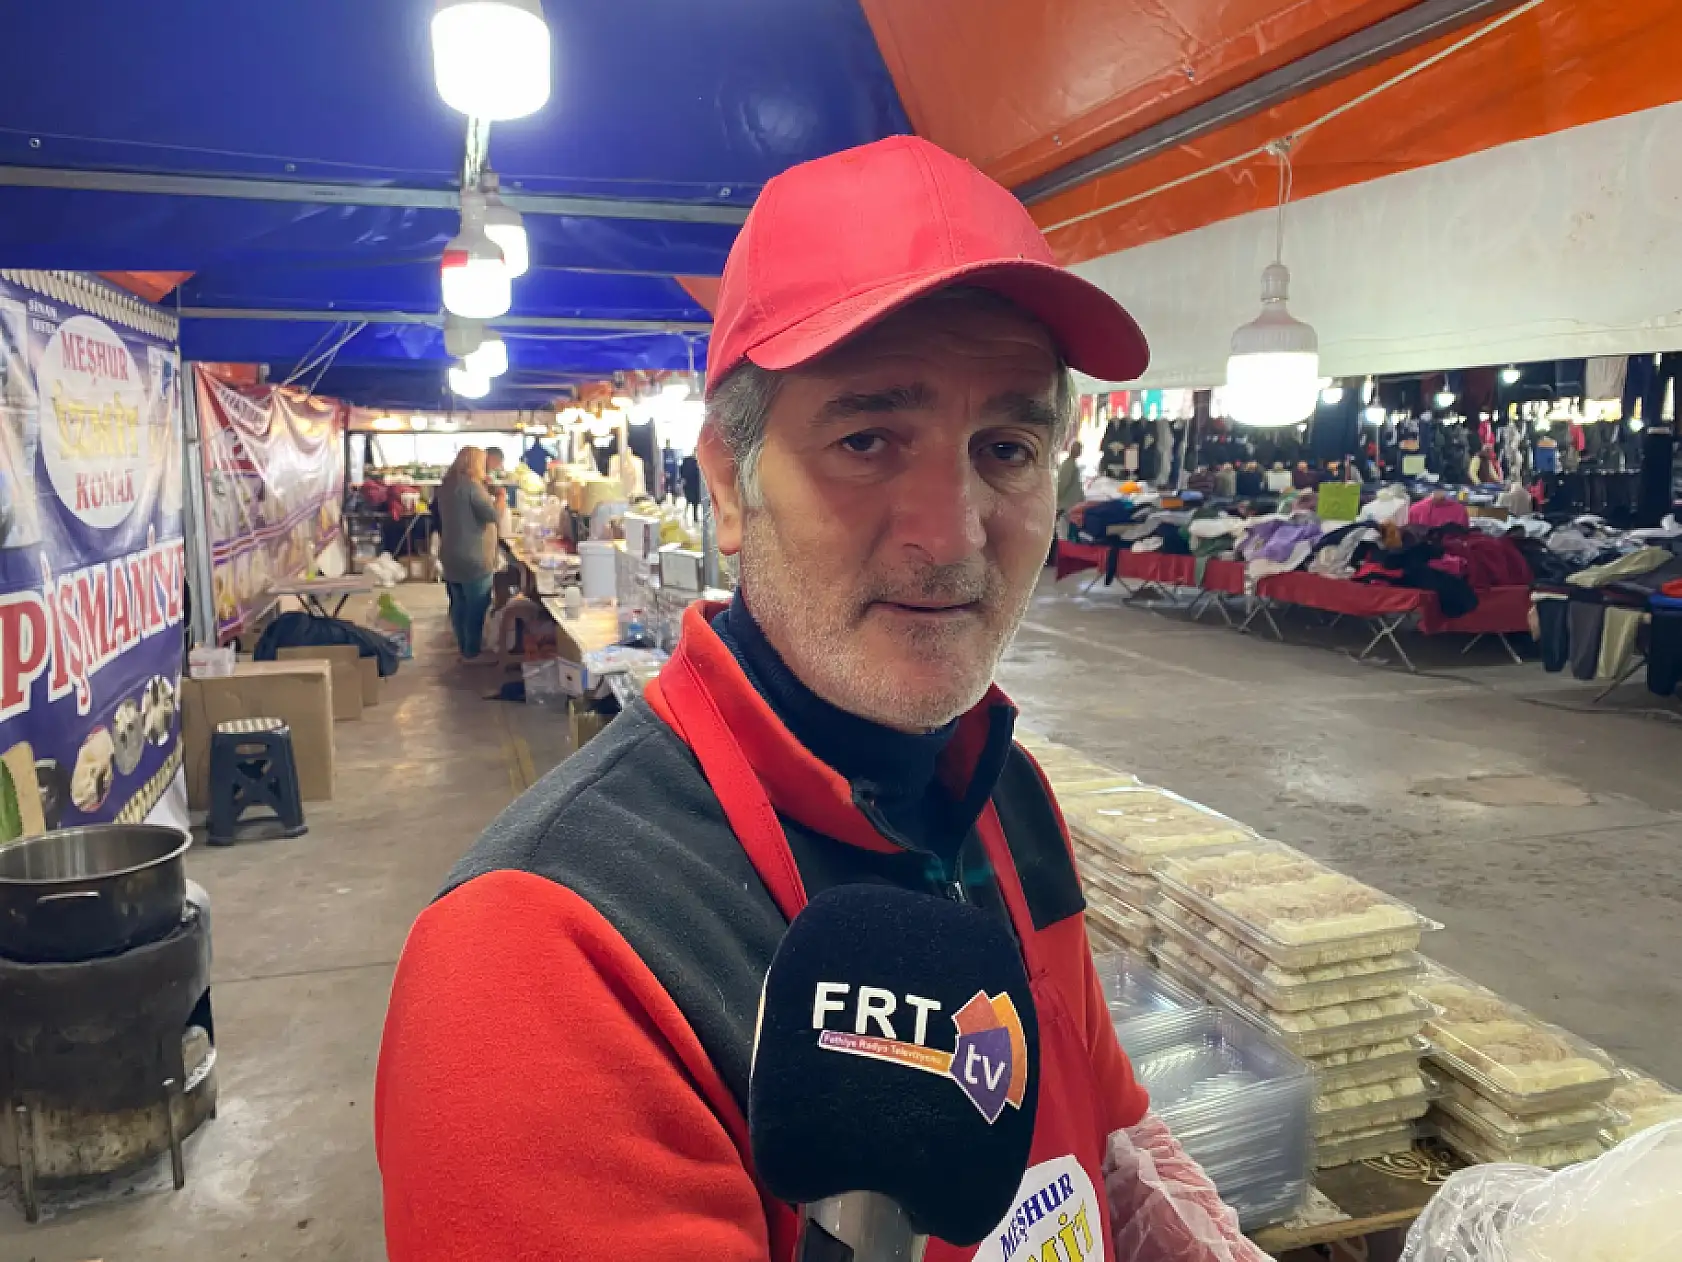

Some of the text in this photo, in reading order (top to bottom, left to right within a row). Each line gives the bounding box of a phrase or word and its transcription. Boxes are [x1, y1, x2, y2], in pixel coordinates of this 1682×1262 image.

[60, 331, 129, 386] MEŞHUR
[52, 379, 139, 460] İZMİT
[76, 469, 134, 511] KONAK
[812, 981, 941, 1046] FRT
[964, 1043, 1007, 1091] tv
[1000, 1173, 1074, 1262] MEŞHUR
